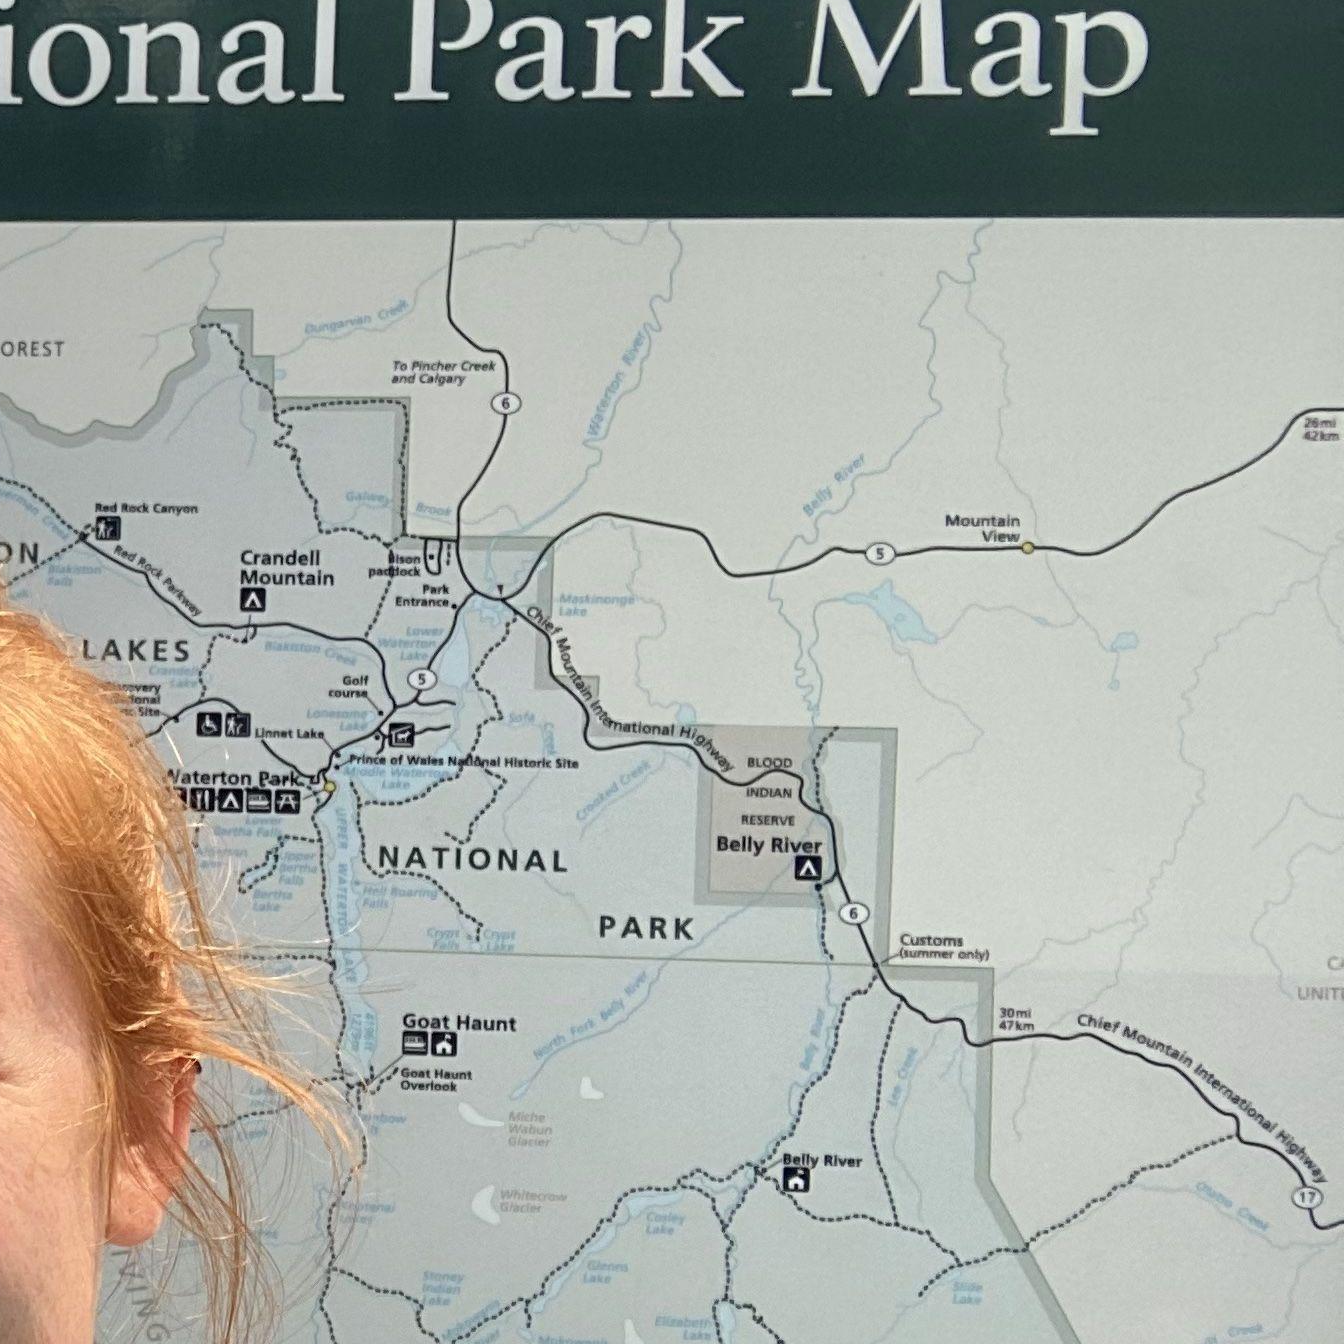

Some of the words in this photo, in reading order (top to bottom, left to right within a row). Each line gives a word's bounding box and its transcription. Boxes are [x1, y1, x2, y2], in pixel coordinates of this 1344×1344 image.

[392, 360, 408, 372] To
[411, 360, 458, 372] Pincher
[461, 361, 496, 373] Creek
[391, 373, 415, 384] and
[419, 373, 466, 386] Calgary
[586, 370, 625, 437] Waterton
[621, 330, 647, 366] River
[501, 398, 511, 410] 6
[94, 503, 118, 514] Red
[121, 503, 151, 514] Rock
[152, 503, 199, 516] Canyon
[945, 515, 1021, 528] Mountain
[982, 530, 1020, 544] View
[240, 550, 321, 566] Crandell
[875, 548, 885, 560] 5
[112, 544, 137, 567] Red
[136, 554, 163, 582] Rock
[161, 575, 203, 618] Parkway
[240, 569, 335, 587] Mountain
[422, 584, 450, 595] Park
[395, 597, 450, 608] Entrance
[82, 639, 191, 662] LAKES
[342, 675, 369, 686] Golf
[418, 674, 427, 685] 5
[328, 689, 368, 699] course
[527, 605, 563, 636] Chief
[556, 637, 593, 704] Mountain
[590, 698, 675, 735] International
[679, 724, 736, 774] Highway
[254, 728, 293, 739] Linnet
[296, 729, 325, 739] Lake
[349, 755, 387, 766] Prince
[390, 756, 405, 766] of
[407, 756, 445, 767] Wales
[447, 757, 501, 768] National
[504, 758, 553, 768] Historic
[555, 759, 580, 769] Site
[747, 756, 793, 769] BLOOD
[258, 771, 300, 787] Park
[745, 786, 793, 799] INDIAN
[740, 814, 796, 826] RESERVE
[716, 835, 765, 856] Belly
[771, 836, 823, 854] River
[378, 845, 569, 874] NATIONAL
[849, 907, 859, 919] 6
[598, 915, 696, 941] PARK
[899, 933, 964, 947] Customs
[899, 947, 955, 960] (summer
[957, 947, 991, 961] only)
[402, 1013, 450, 1031] Goat
[456, 1015, 517, 1032] Haunt
[400, 1068, 429, 1080] Goat
[434, 1069, 473, 1081] Haunt
[400, 1081, 458, 1093] Overlook
[1076, 1013, 1121, 1035] Chief
[1122, 1025, 1194, 1068] Mountain
[1193, 1062, 1276, 1134] International
[1275, 1127, 1324, 1183] Highway
[783, 1153, 819, 1169] Belly
[823, 1154, 863, 1168] River
[1299, 1192, 1316, 1204] 17
